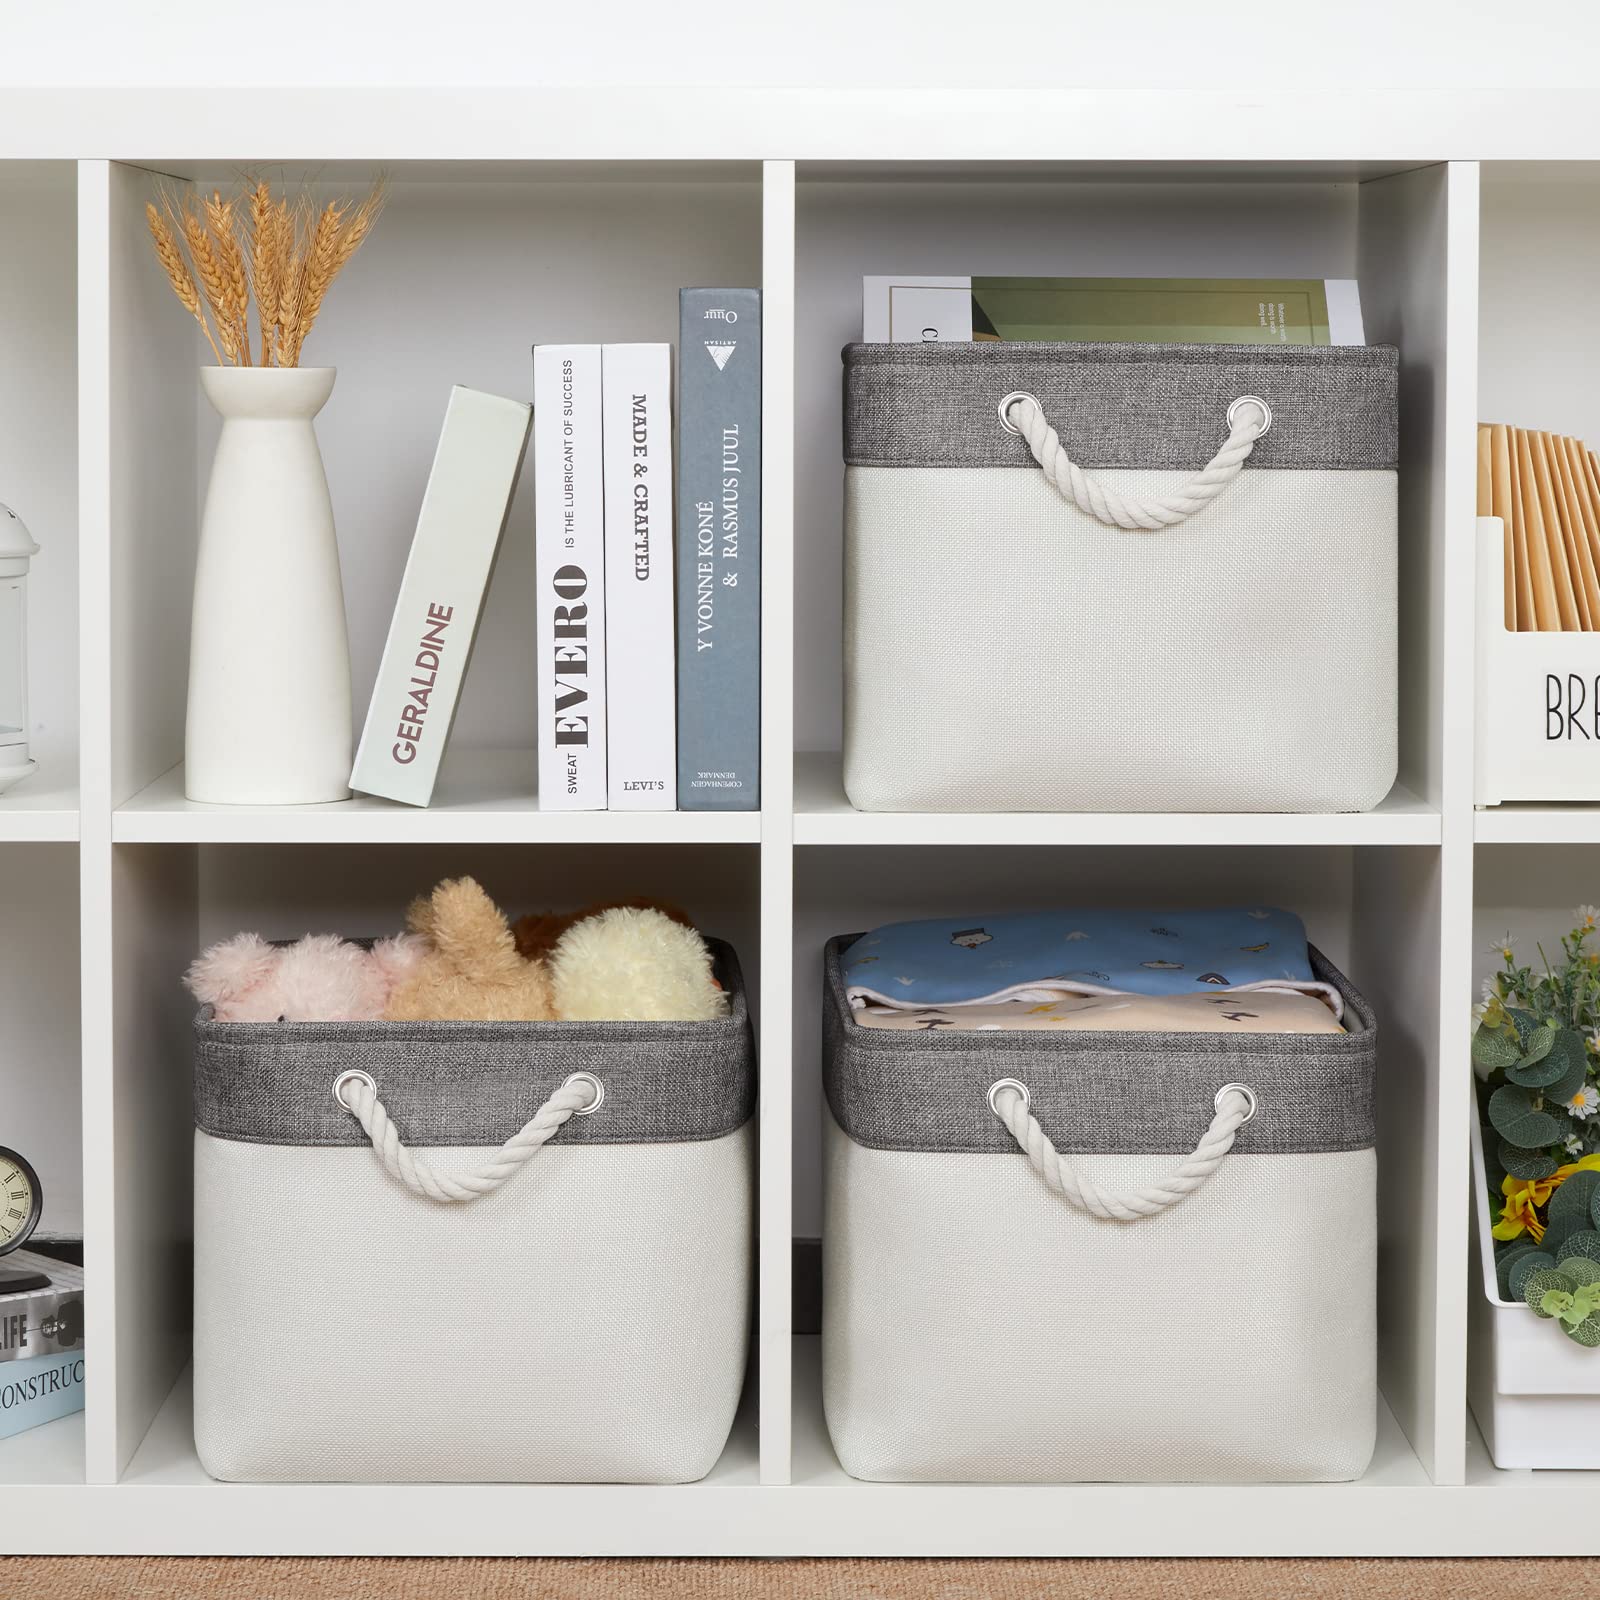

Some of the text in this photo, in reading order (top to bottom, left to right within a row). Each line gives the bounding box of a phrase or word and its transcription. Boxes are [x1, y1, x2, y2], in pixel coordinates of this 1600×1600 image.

[704, 310, 737, 323] Ouur
[633, 394, 649, 581] MADE & CRAFTED
[723, 424, 741, 586] & RASMUS JUUL
[696, 502, 713, 556] KONÉ
[553, 360, 588, 793] SWEAT EVERO IS THE LUBRICANT OF SUCCESS
[392, 602, 454, 765] GERALDINE
[624, 781, 664, 790] LEVI'S
[691, 780, 743, 788] COPENHAGEN
[0, 1315, 27, 1350] IFE
[0, 1360, 84, 1409] ONSTRUC
